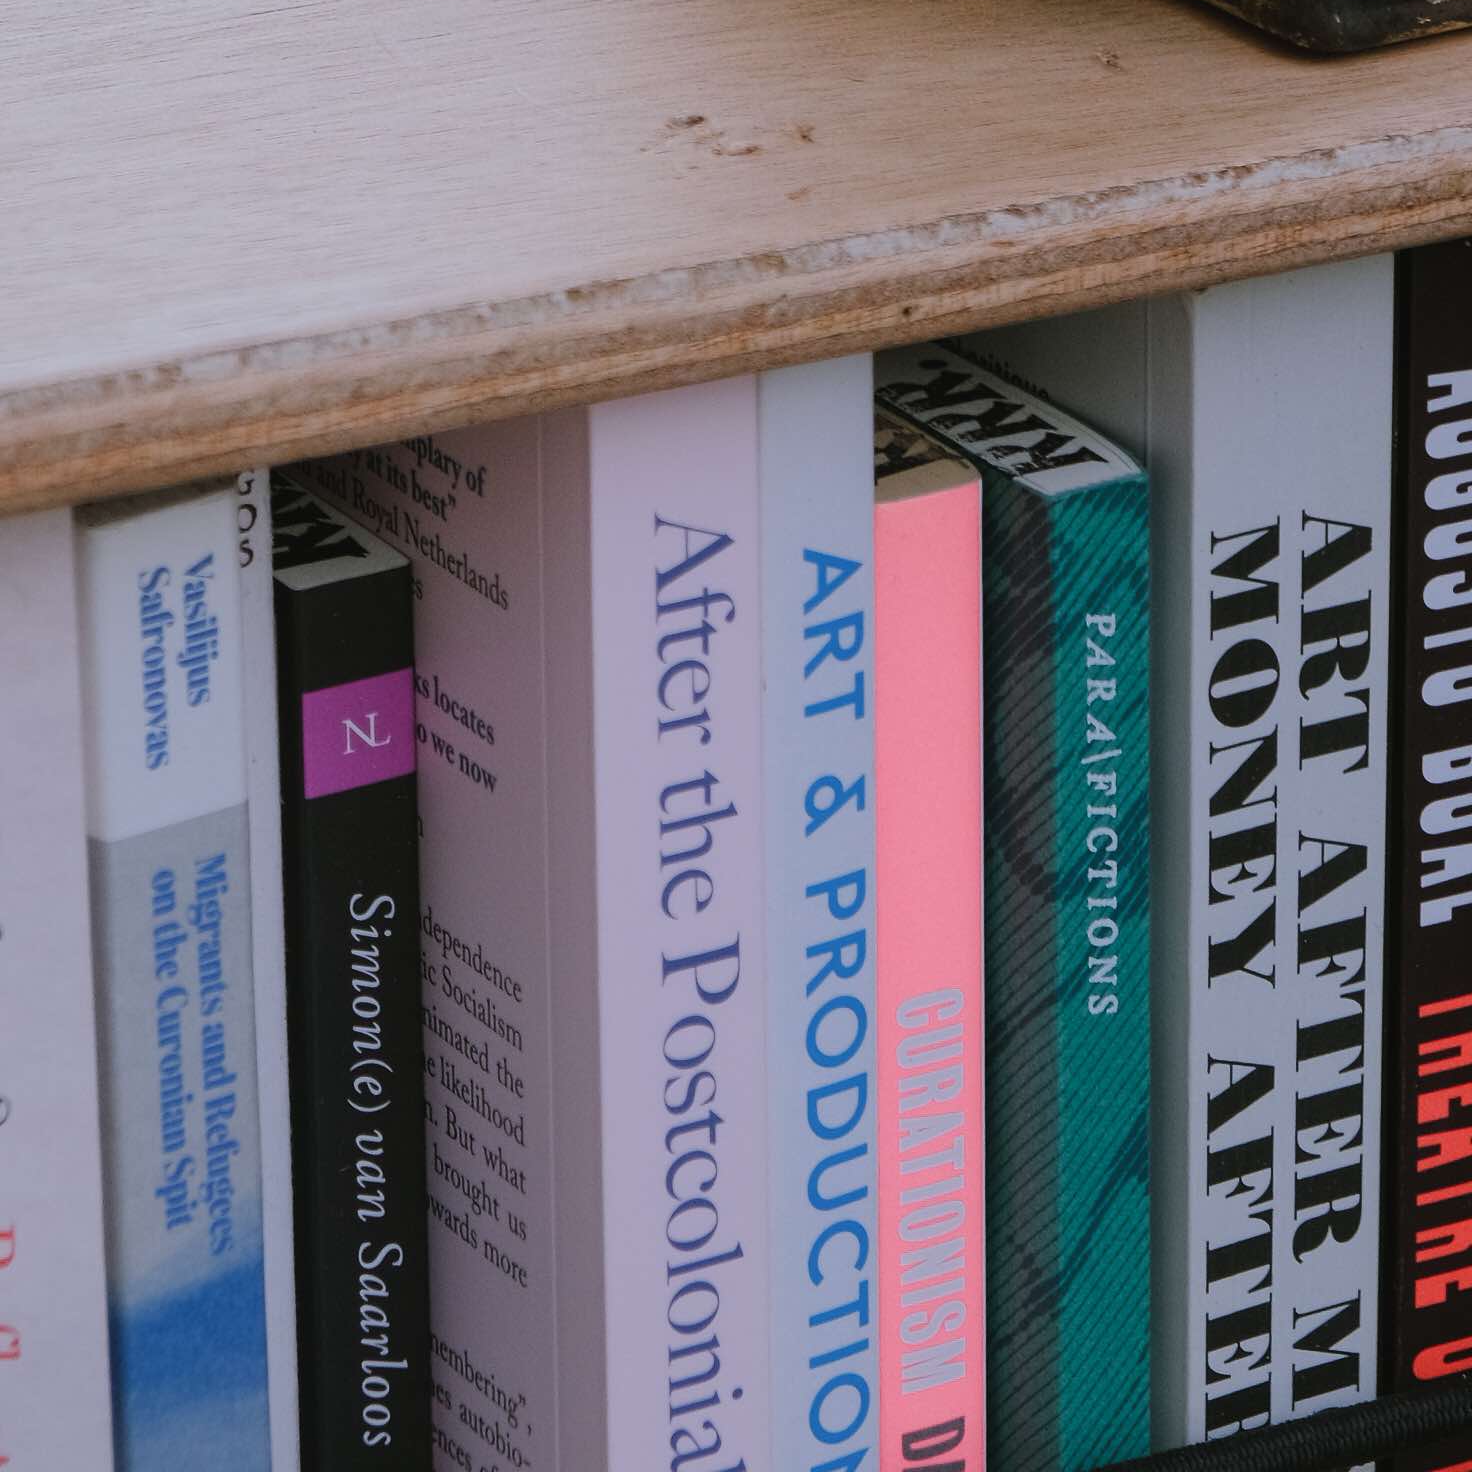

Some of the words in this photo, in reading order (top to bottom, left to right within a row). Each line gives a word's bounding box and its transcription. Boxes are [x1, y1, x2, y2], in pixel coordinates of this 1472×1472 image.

[466, 467, 487, 496] of
[352, 475, 399, 536] Royal
[403, 510, 509, 611] Netherlands
[137, 566, 174, 771] Safronovas
[178, 553, 219, 708] Vasilijus
[652, 511, 737, 744] After
[802, 548, 866, 721] ART
[1297, 509, 1373, 775] ART
[433, 675, 495, 745] locates
[1206, 515, 1281, 989] MONEY
[431, 731, 455, 764] we
[459, 752, 497, 792] now
[804, 775, 866, 838] &
[151, 868, 176, 916] on
[657, 770, 739, 920] the
[154, 919, 187, 980] the
[186, 853, 228, 1018] Migrants
[347, 892, 395, 1113] Simon(e)
[422, 1005, 489, 1074] nimated
[496, 1058, 524, 1098] the
[441, 964, 523, 1052] Socialism
[1292, 831, 1369, 1264] AFTER
[155, 984, 194, 1154] Curonian
[202, 1023, 238, 1091] and
[440, 1056, 525, 1146] likelihood
[154, 1156, 198, 1230] Spit
[200, 1092, 241, 1256] Refugees
[350, 1129, 384, 1223] van
[433, 1143, 500, 1221] brought
[508, 1211, 527, 1241] us
[445, 1106, 476, 1156] But
[482, 1145, 526, 1194] what
[896, 987, 967, 1396] CURATIONISM
[483, 1240, 528, 1288] more
[358, 1241, 408, 1448] Saarloos
[459, 1403, 531, 1468] autobio-
